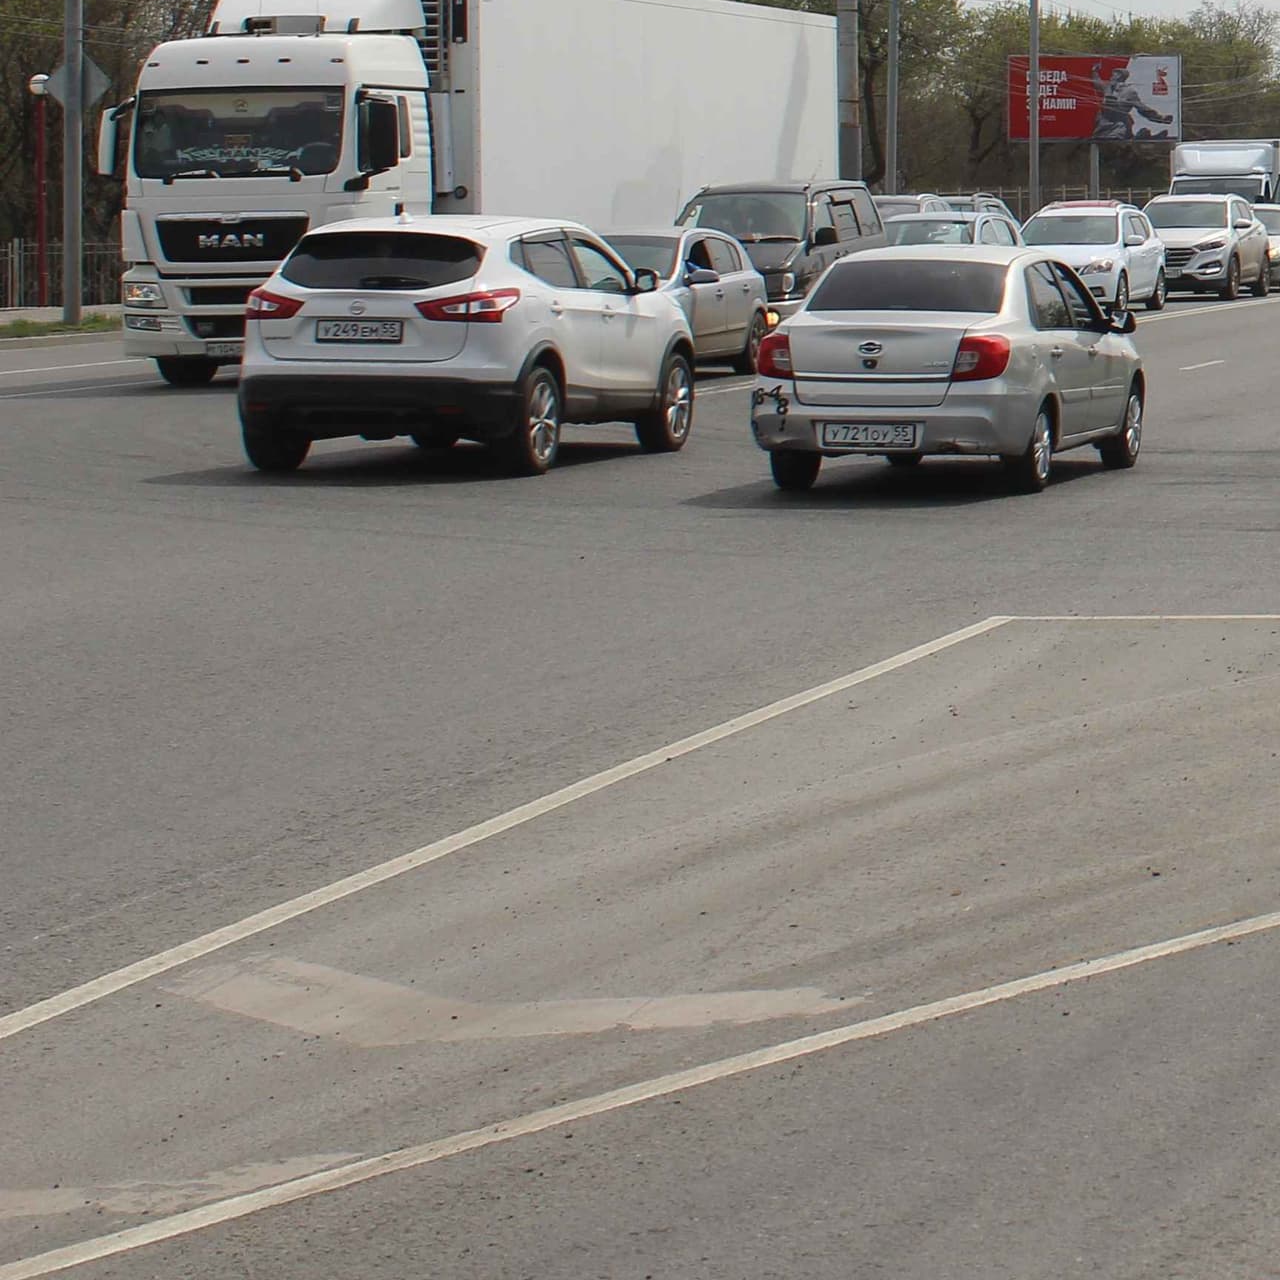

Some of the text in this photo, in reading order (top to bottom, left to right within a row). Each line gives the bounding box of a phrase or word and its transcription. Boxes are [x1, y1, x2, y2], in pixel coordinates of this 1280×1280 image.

[1026, 71, 1068, 84] БЕДА
[1026, 85, 1058, 98] ДЕТ
[1043, 98, 1076, 110] НАМИ!
[198, 233, 264, 248] MAN
